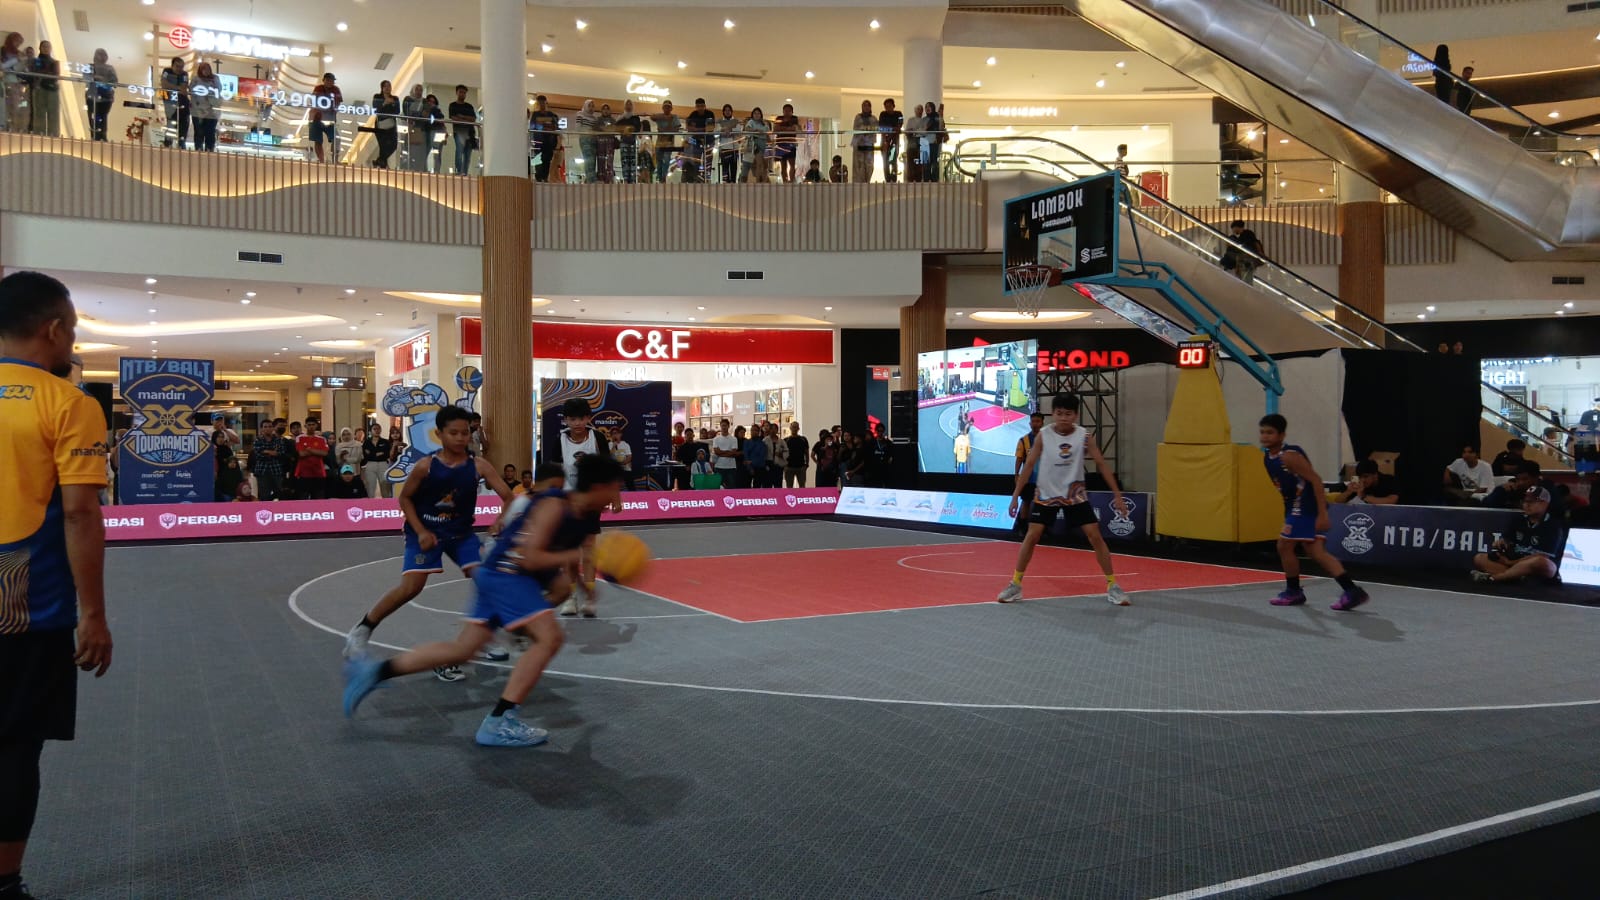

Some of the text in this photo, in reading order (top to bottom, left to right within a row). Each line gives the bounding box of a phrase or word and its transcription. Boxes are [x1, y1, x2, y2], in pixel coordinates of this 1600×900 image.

[1031, 188, 1083, 220] LOMBOK
[616, 329, 691, 359] C&F
[1037, 350, 1130, 371] ECOND
[1180, 348, 1203, 365] 00
[138, 390, 186, 400] mandiri
[131, 431, 205, 454] TOURNAMENT
[670, 499, 715, 508] PERBASI
[735, 498, 778, 506] PERBASI
[796, 496, 837, 504] PERBASI
[178, 514, 242, 525] PERBASI
[273, 511, 335, 522] PERBASI
